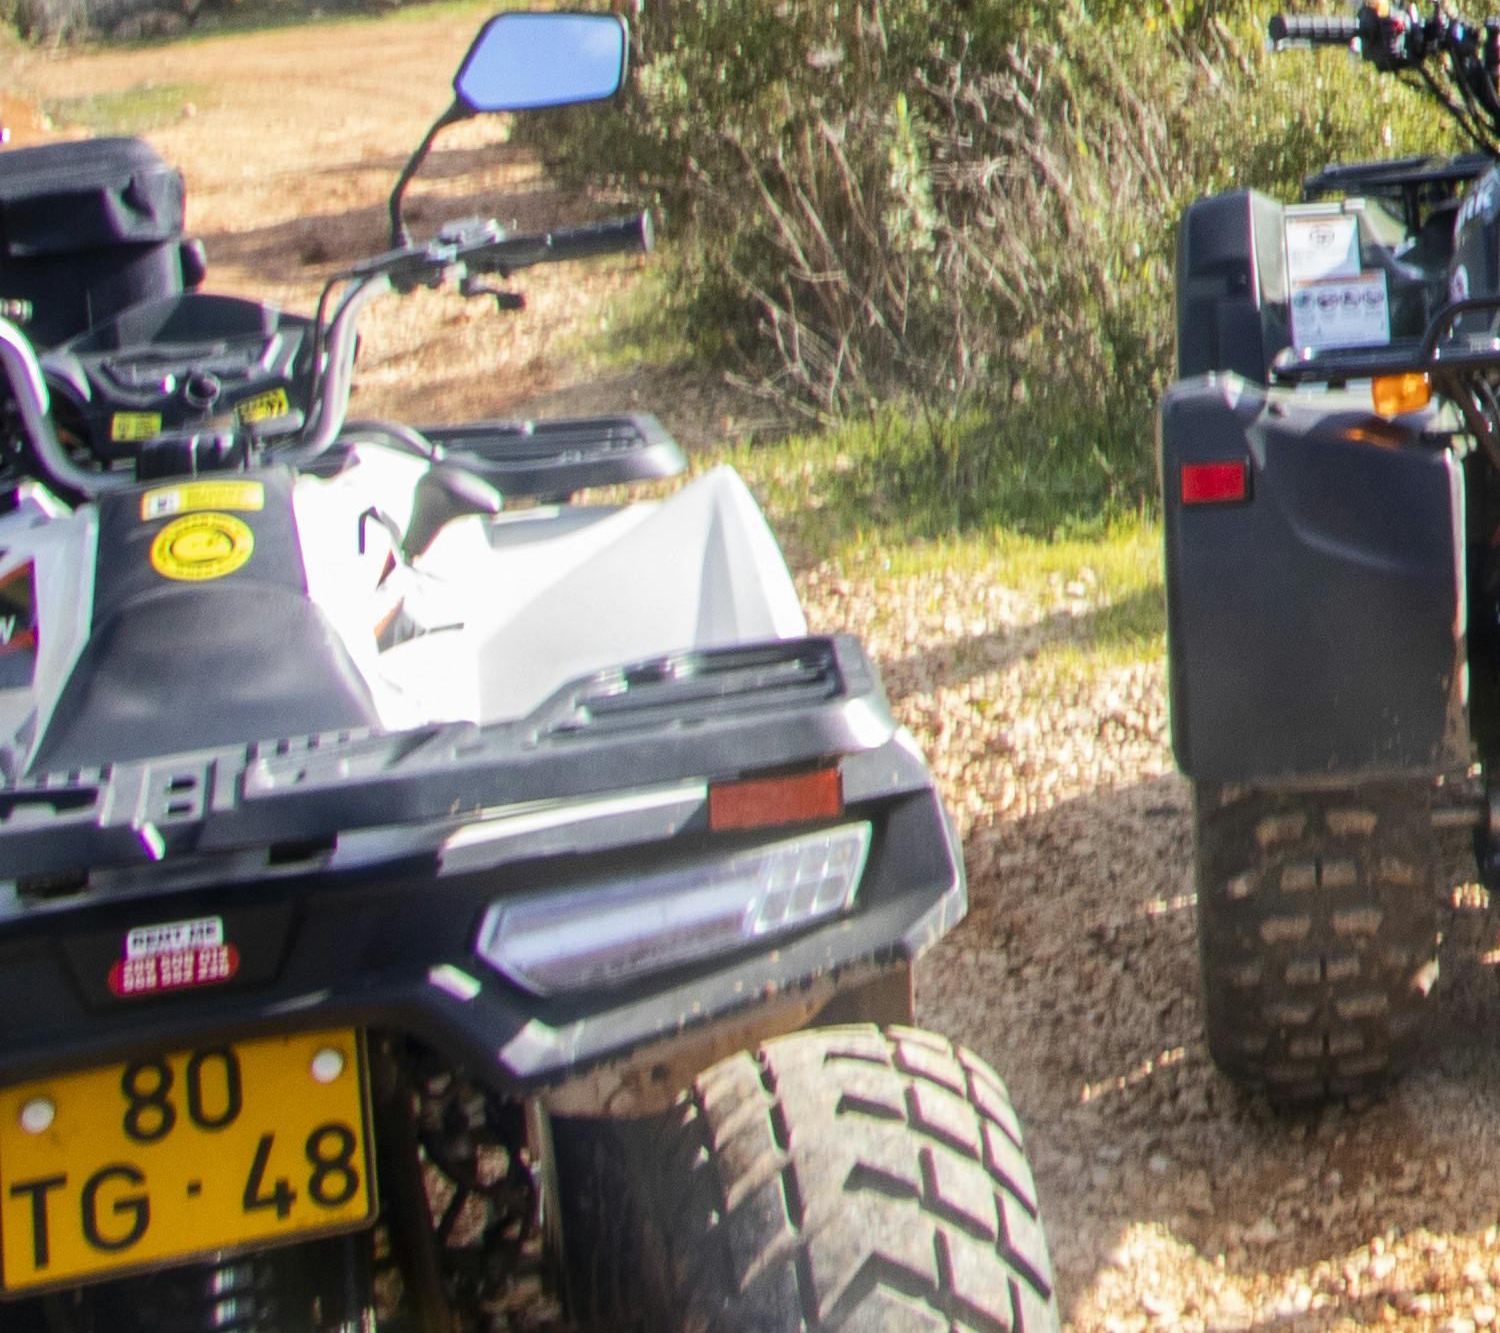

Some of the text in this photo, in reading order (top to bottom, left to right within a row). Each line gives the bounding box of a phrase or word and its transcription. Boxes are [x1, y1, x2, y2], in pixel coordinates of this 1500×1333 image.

[121, 1045, 243, 1147] 80
[9, 1121, 359, 1271] TG 48
